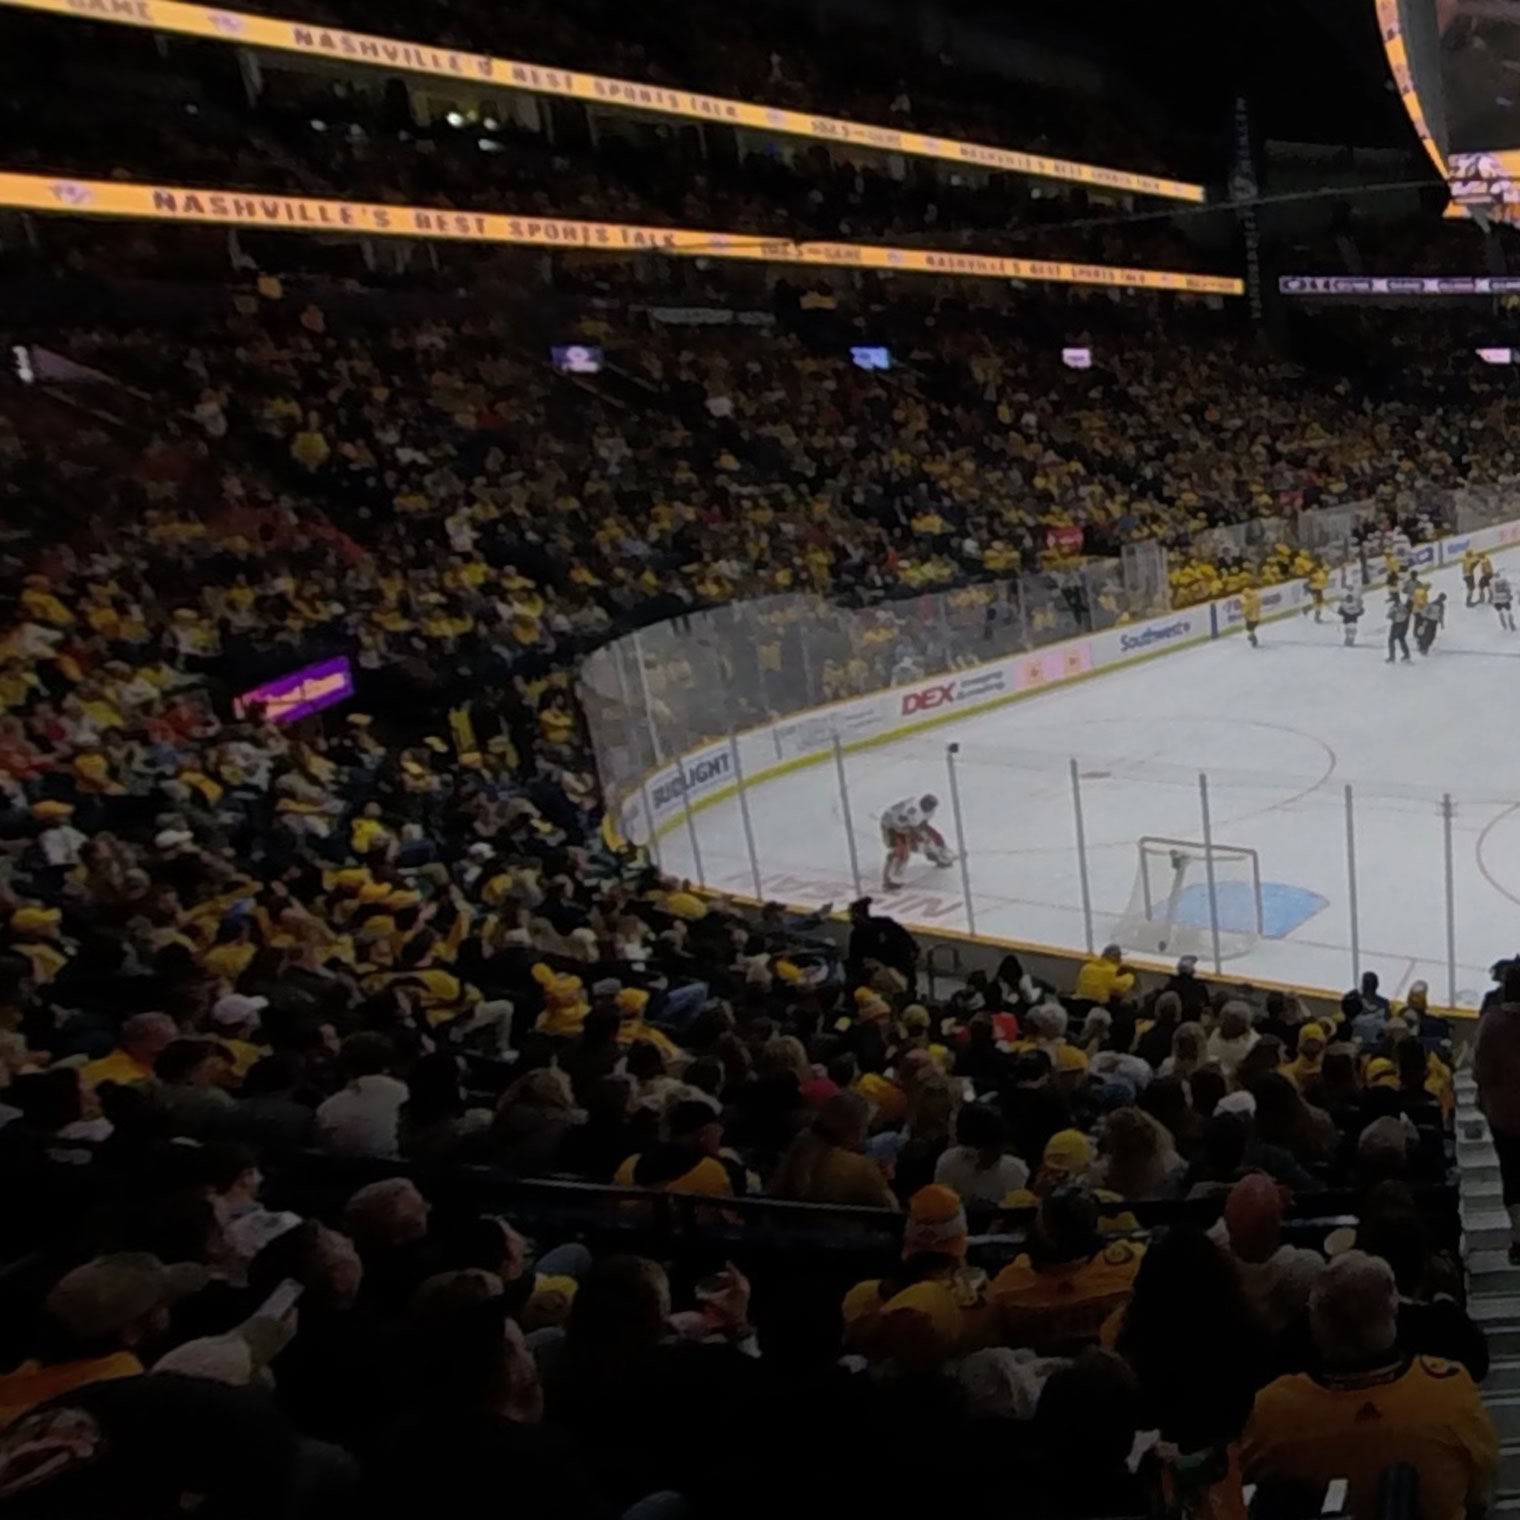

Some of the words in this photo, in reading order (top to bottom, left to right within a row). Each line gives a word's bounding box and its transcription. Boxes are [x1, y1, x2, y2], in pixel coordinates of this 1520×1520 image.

[153, 190, 391, 228] NASHVILLE'S
[414, 211, 486, 235] BEST
[507, 220, 610, 246] SPORTS
[620, 228, 678, 248] TALK
[902, 680, 956, 716] DEX
